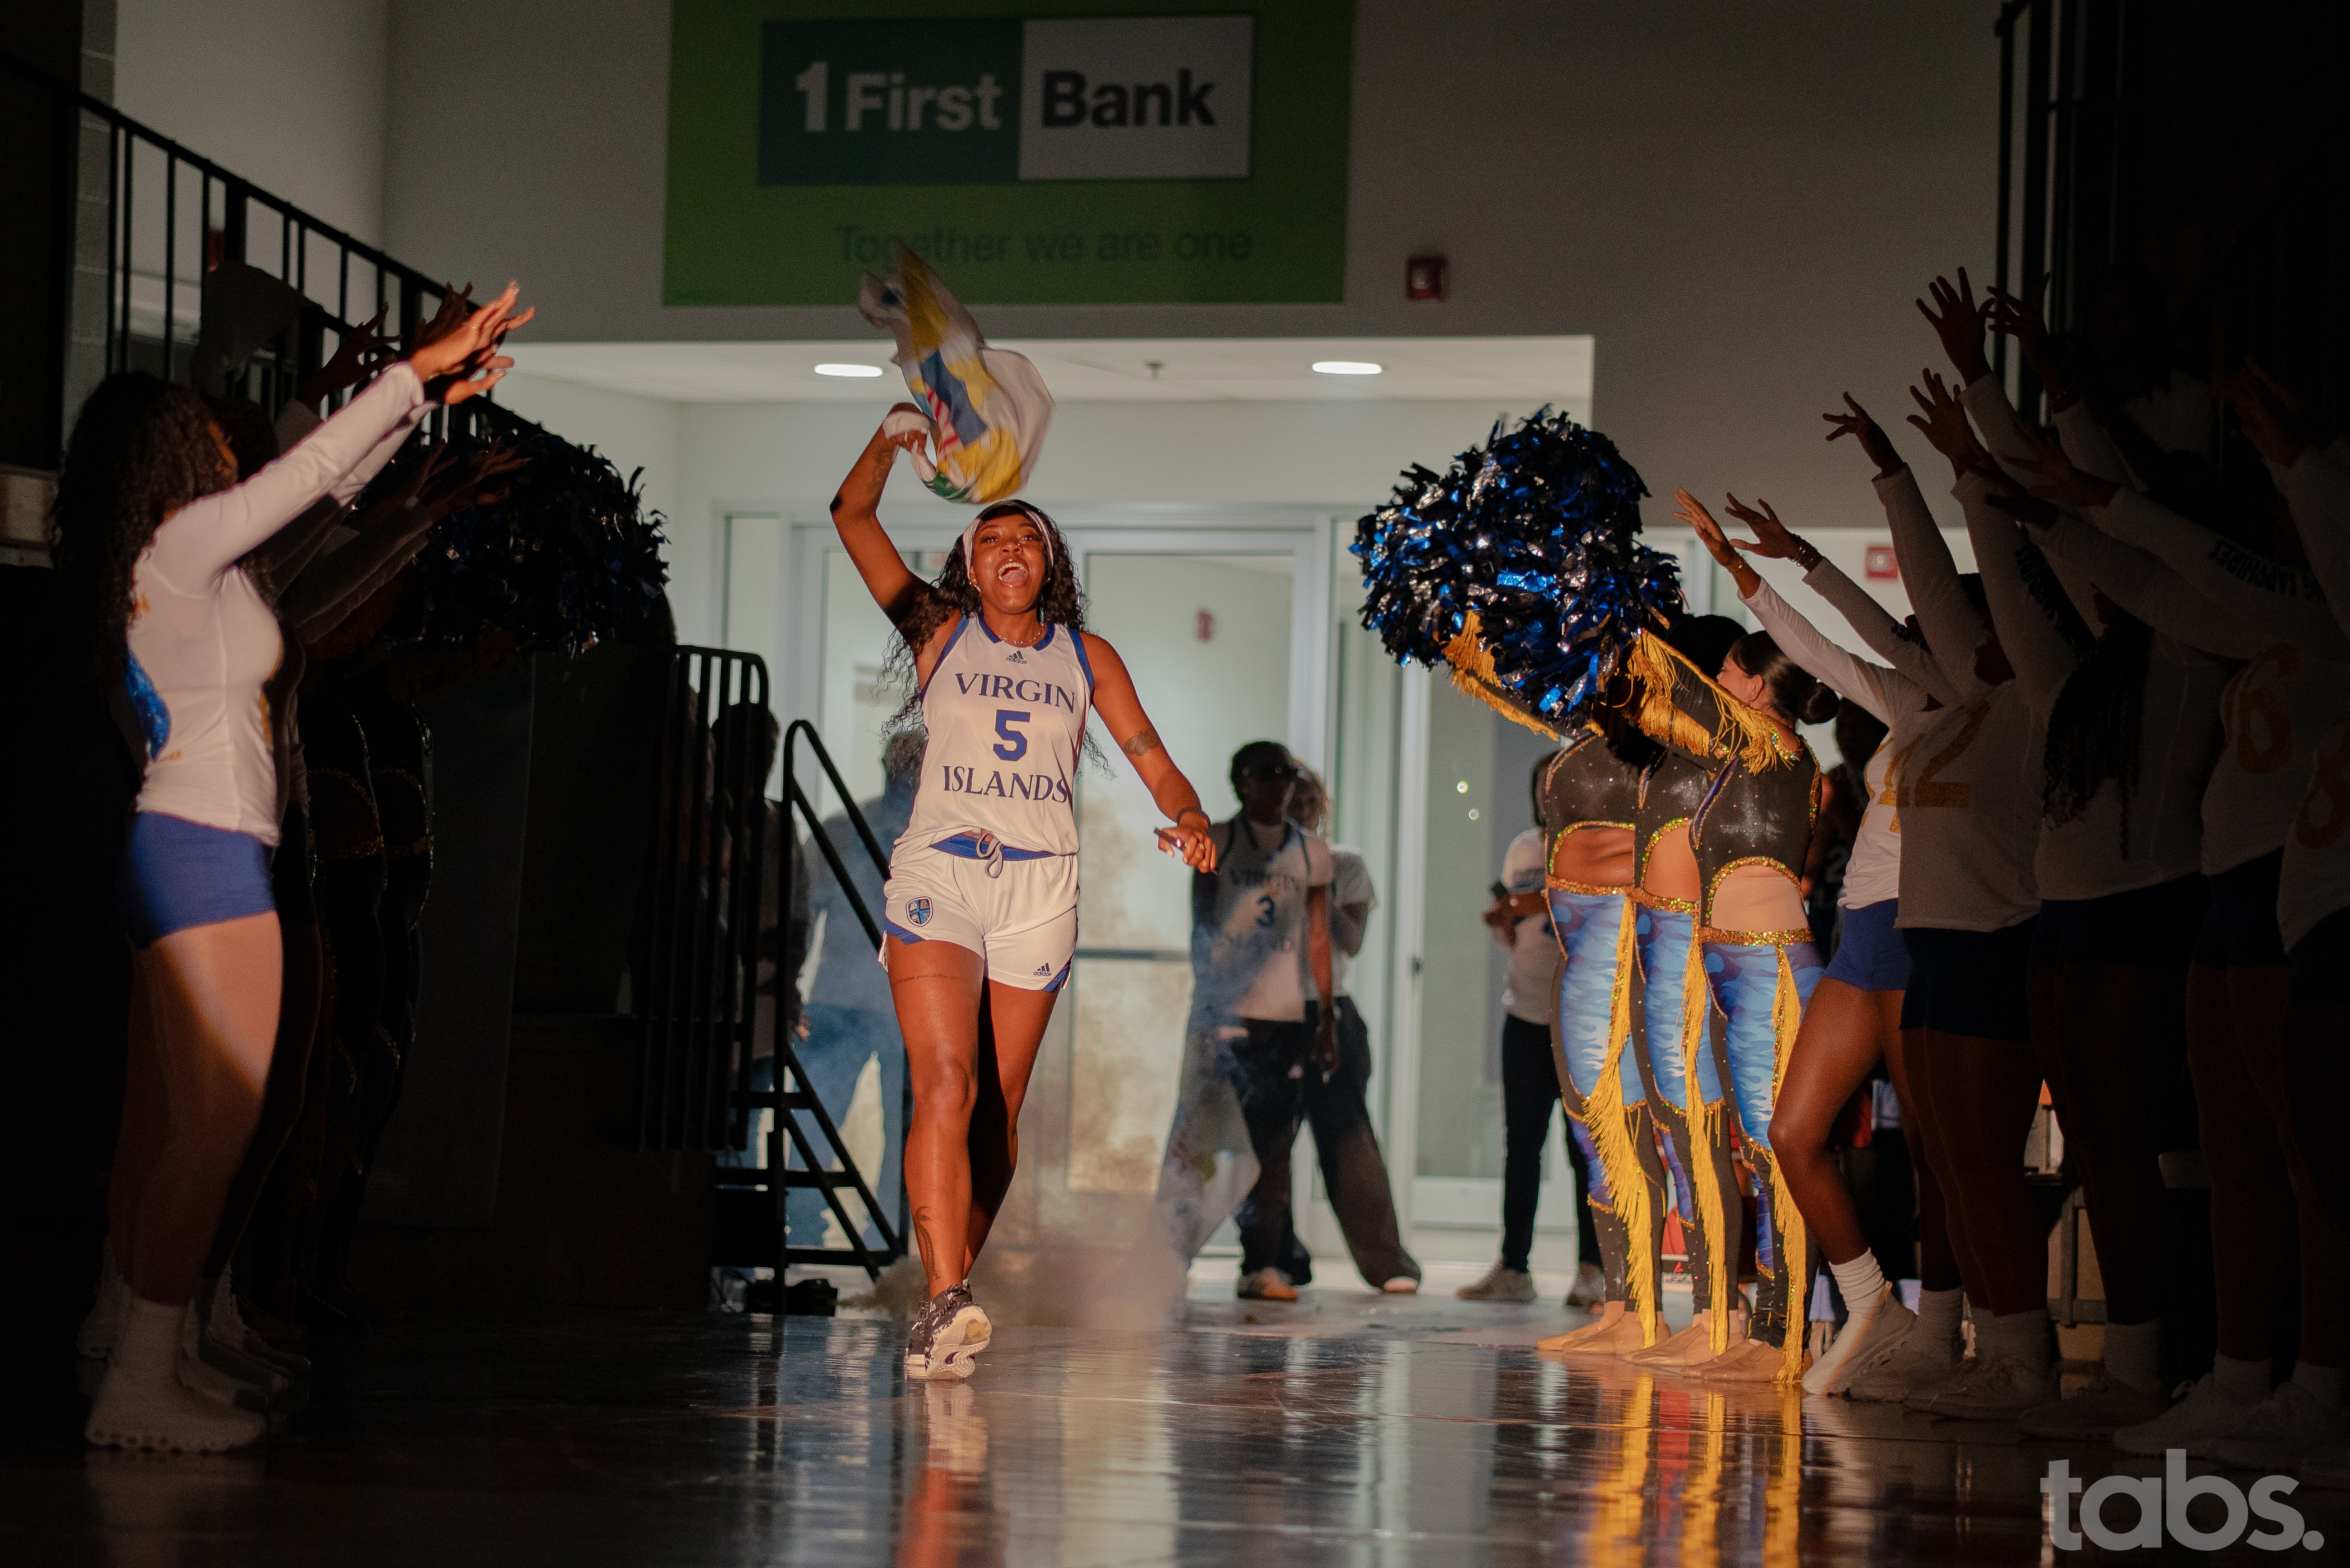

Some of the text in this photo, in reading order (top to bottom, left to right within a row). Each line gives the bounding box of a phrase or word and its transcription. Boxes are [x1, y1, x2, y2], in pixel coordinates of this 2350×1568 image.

[844, 69, 1003, 132] First
[1042, 68, 1216, 128] Bank
[1024, 230, 1083, 263] we
[1097, 229, 1161, 262] are
[1175, 229, 1253, 263] one
[955, 673, 1075, 714] VIRGIN
[993, 709, 1031, 762] 5
[943, 766, 1069, 804] ISLANDS
[1257, 895, 1275, 927] 3
